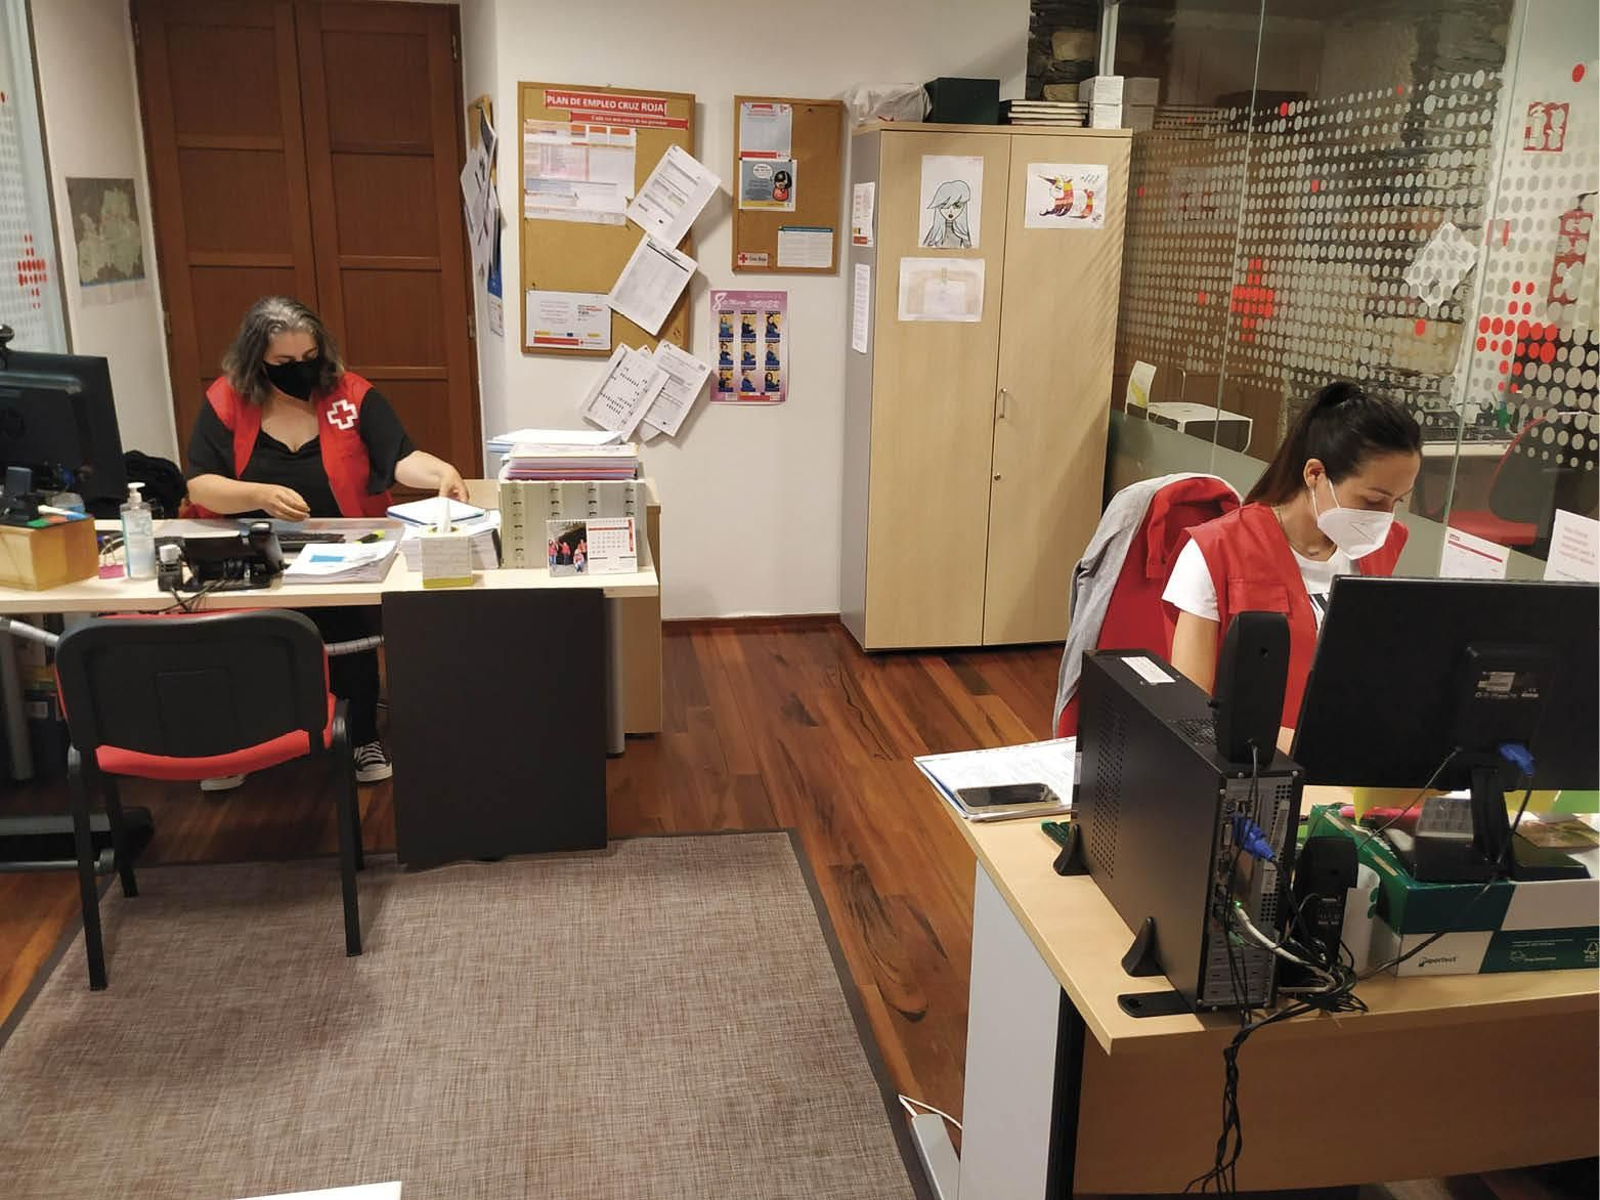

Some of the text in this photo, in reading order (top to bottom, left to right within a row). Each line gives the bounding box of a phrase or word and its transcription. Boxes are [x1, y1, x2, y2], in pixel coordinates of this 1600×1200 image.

[547, 95, 664, 112] PLAN DE EMPLEO CRUZ ROJA
